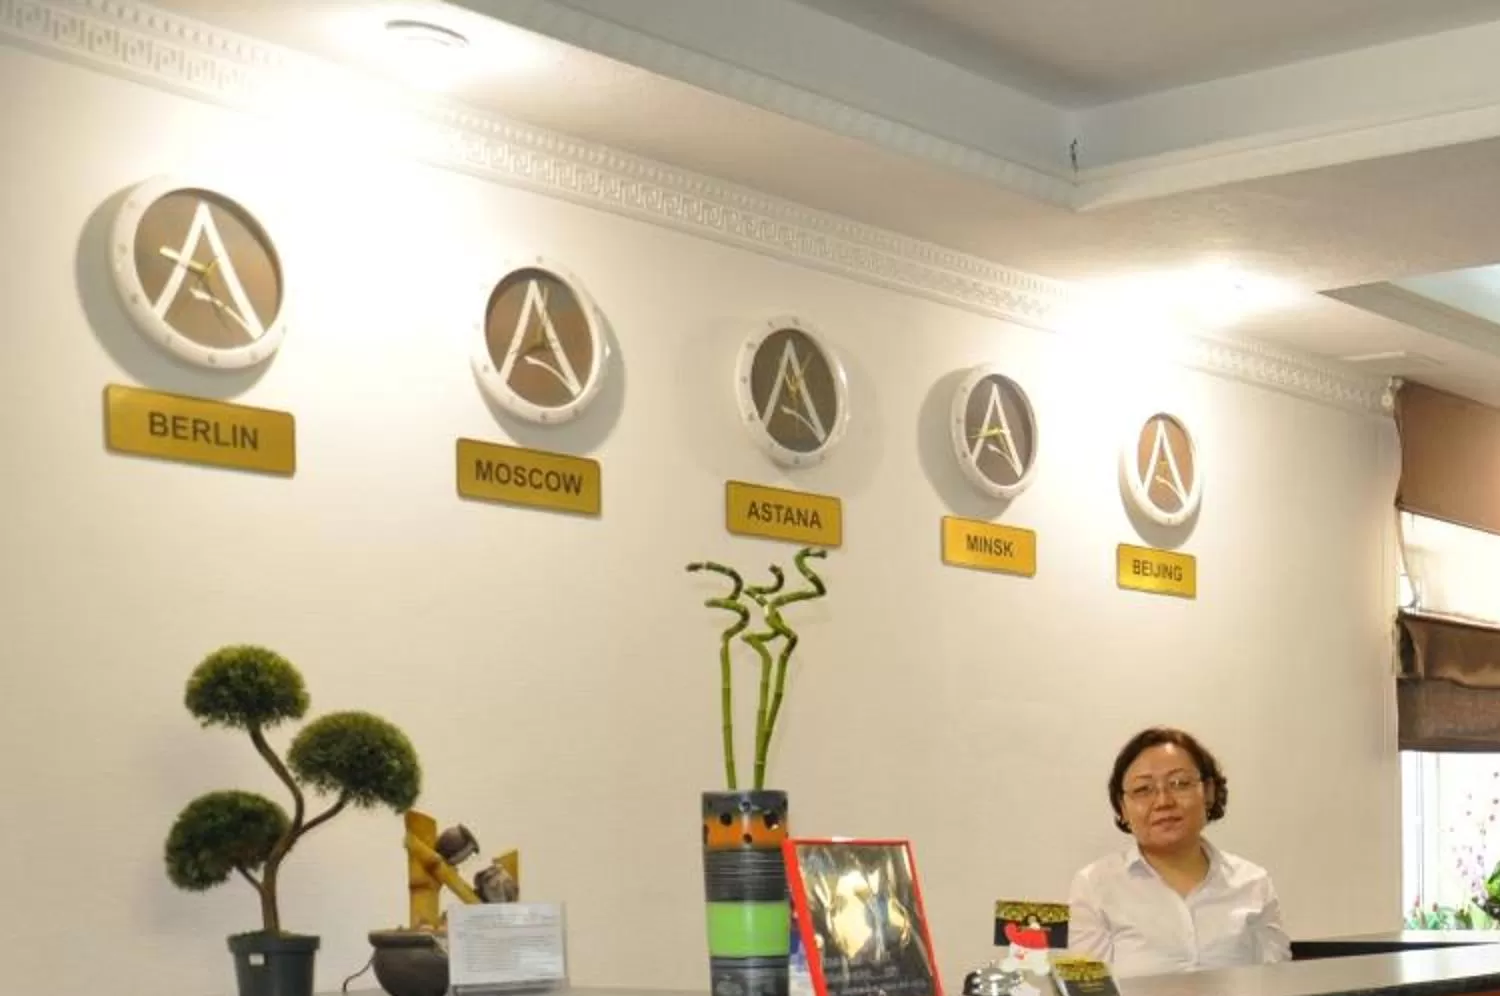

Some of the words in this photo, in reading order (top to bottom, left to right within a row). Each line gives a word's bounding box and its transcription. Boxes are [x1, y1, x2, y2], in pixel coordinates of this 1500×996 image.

[148, 411, 258, 451] BERLIN
[475, 460, 584, 497] MOSCOW
[747, 500, 822, 529] ASTANA
[966, 534, 1013, 557] MINSK
